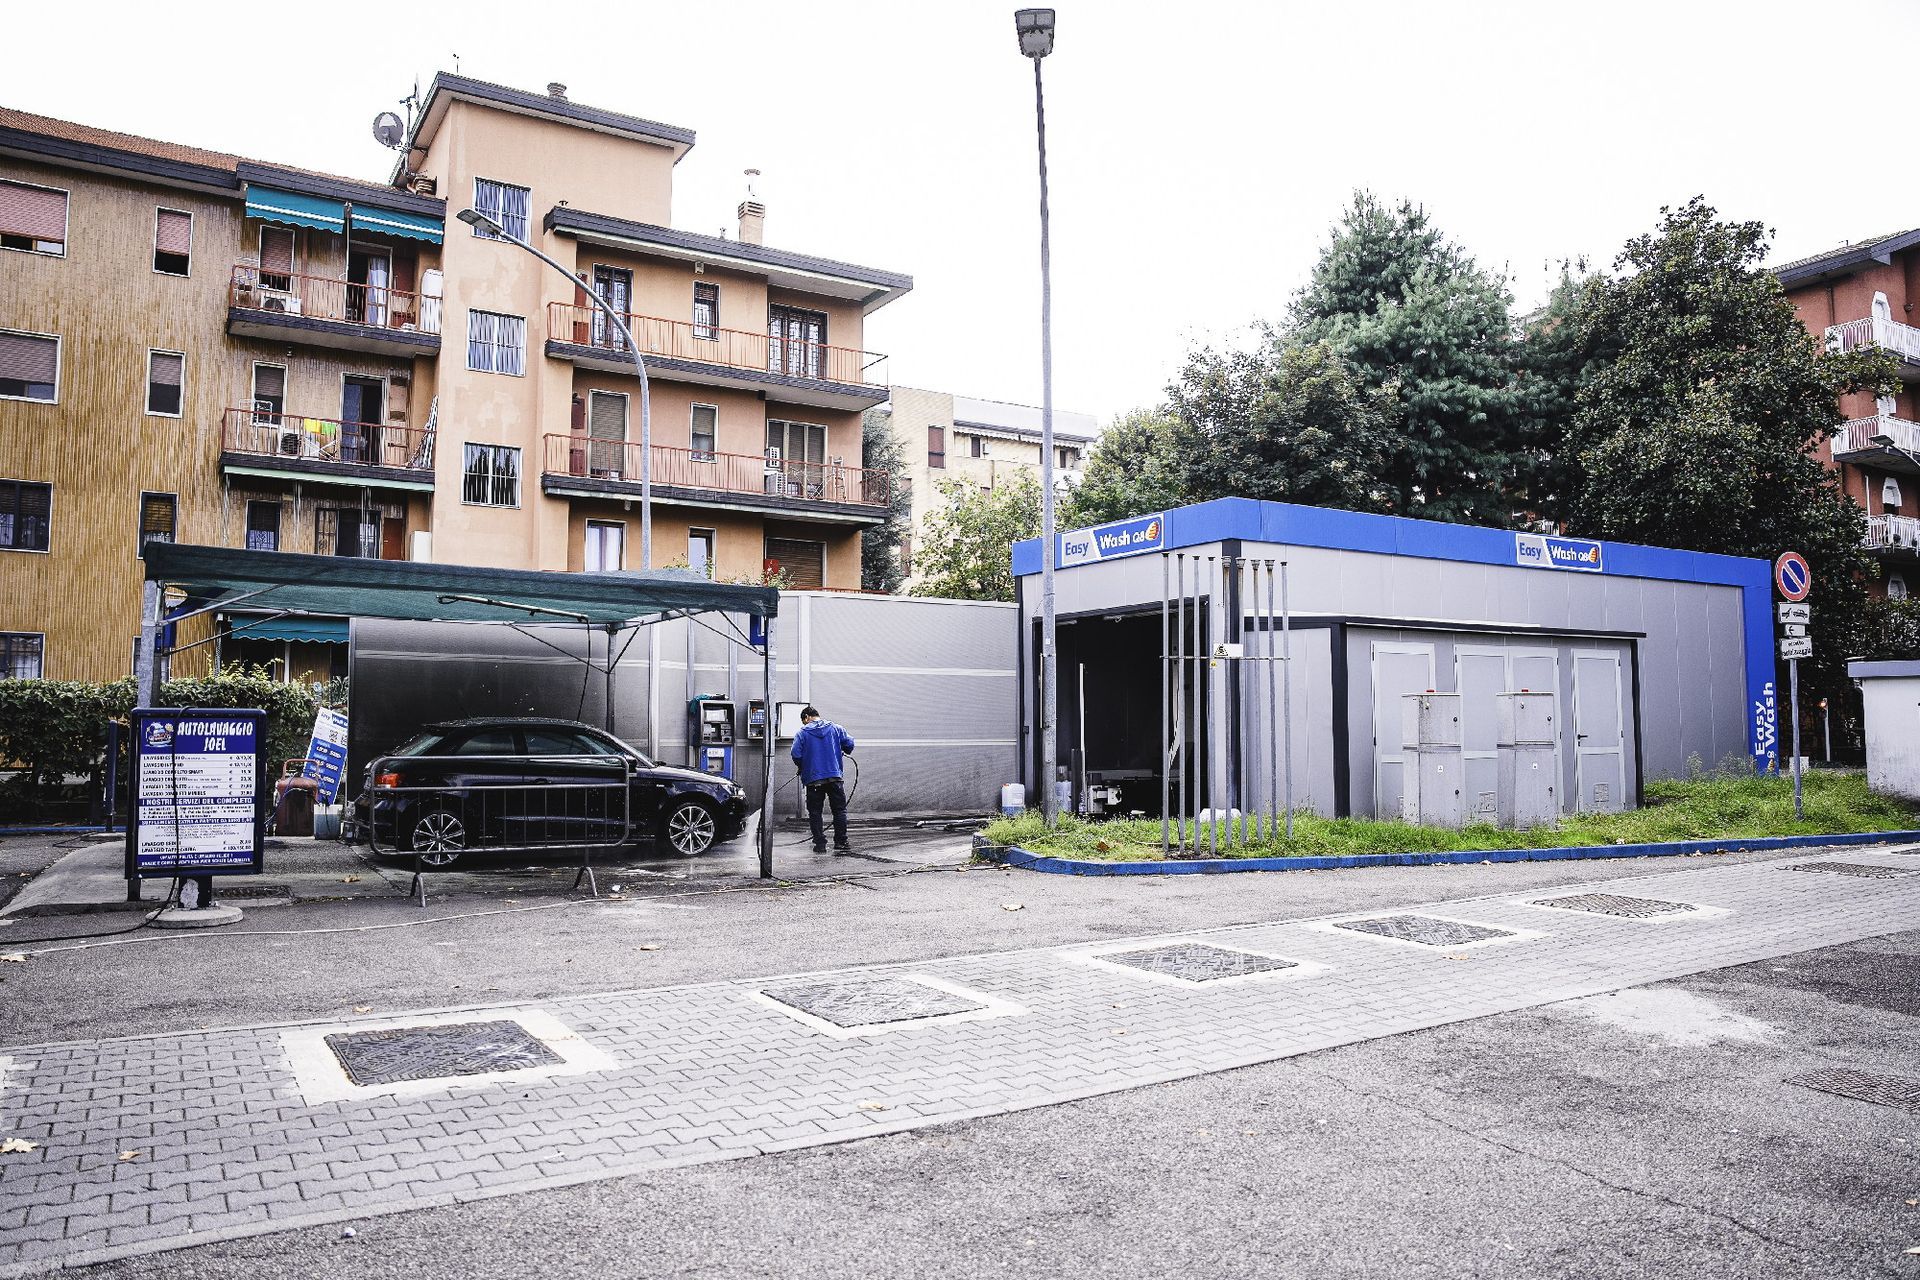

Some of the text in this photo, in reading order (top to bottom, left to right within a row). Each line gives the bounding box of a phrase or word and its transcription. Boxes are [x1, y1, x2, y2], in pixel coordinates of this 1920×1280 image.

[1065, 542, 1089, 556] Easy
[1099, 530, 1130, 550] Wash
[1519, 543, 1541, 560] Easy
[1551, 545, 1577, 560] Wash
[1763, 682, 1775, 748] Wash
[177, 721, 253, 736] AUTOLAVAGGIO
[1755, 701, 1766, 755] Easy
[203, 737, 227, 752] JOEL
[146, 798, 172, 806] NOSTRI
